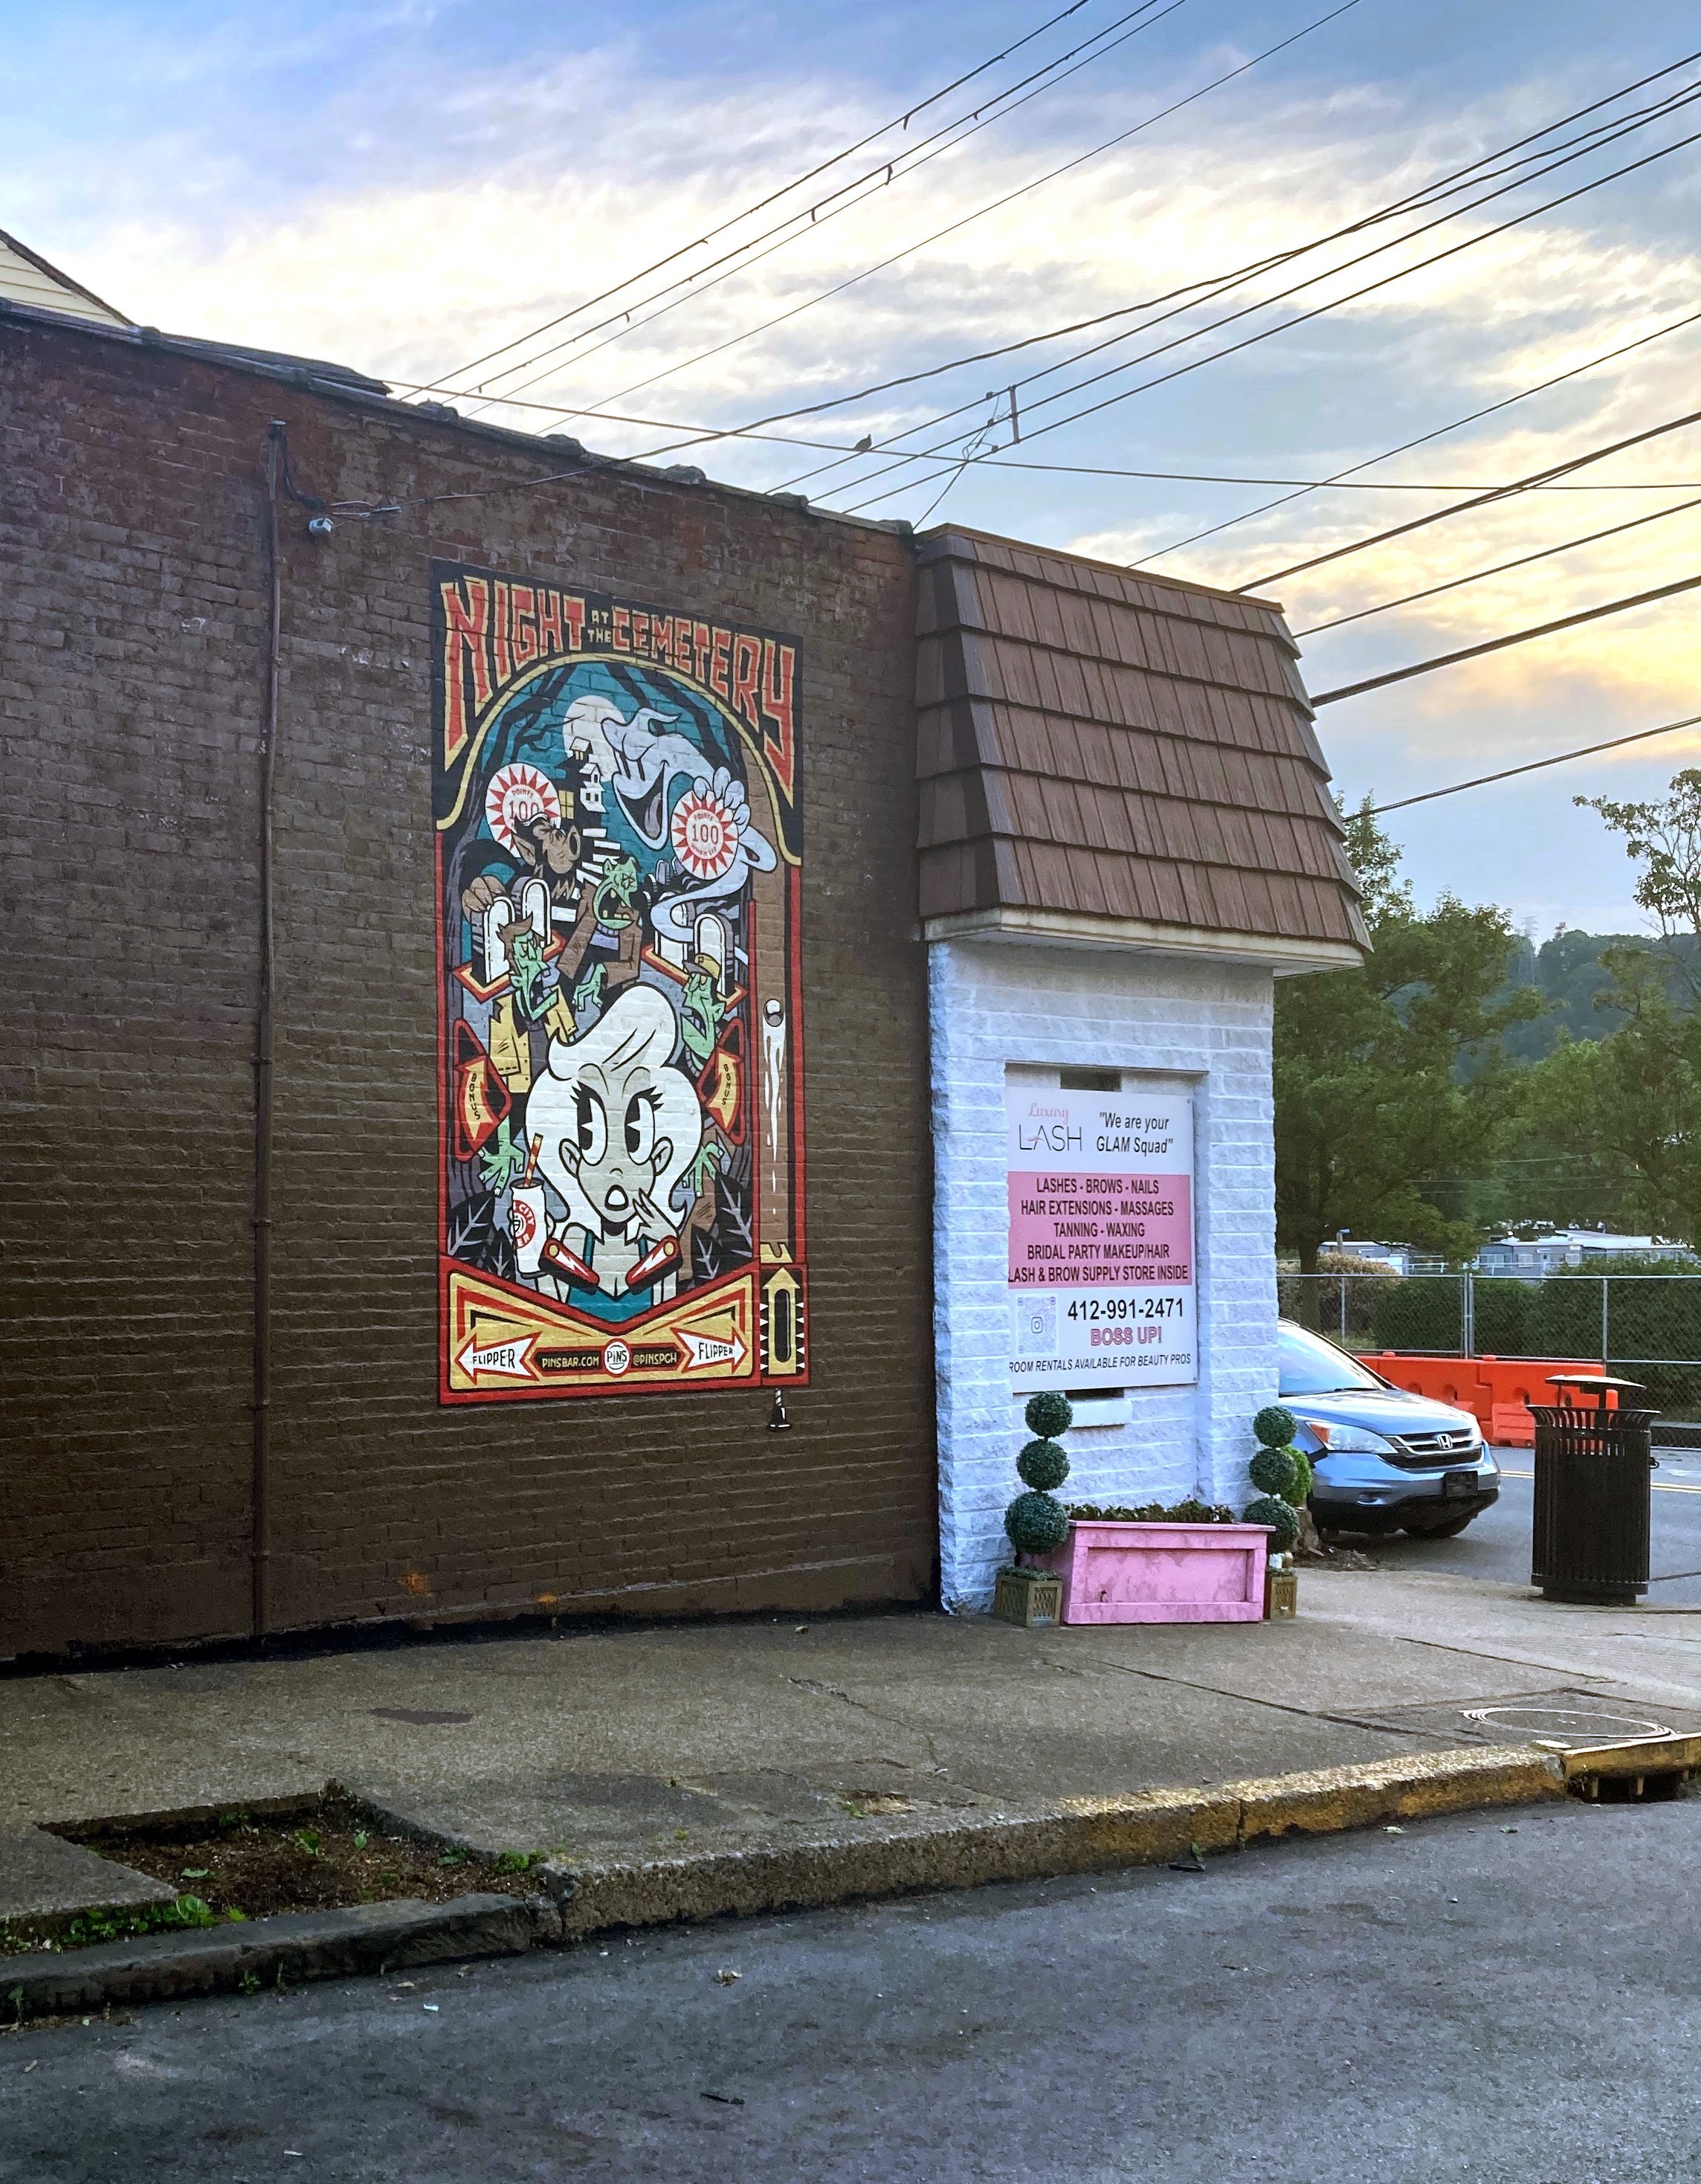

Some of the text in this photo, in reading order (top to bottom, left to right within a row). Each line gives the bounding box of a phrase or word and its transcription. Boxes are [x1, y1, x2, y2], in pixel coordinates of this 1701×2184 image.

[440, 576, 795, 809] NIGHT AT THE CEMETERY
[692, 822, 719, 845] 100
[721, 1063, 731, 1106] BONUS
[468, 1072, 481, 1121] BONUS
[1028, 1102, 1069, 1125] Luxury
[1100, 1112, 1169, 1134] "We are your
[1019, 1124, 1082, 1152] LASH
[1097, 1136, 1174, 1157] GLAM Squad"
[1036, 1177, 1077, 1194] LASHES
[1085, 1179, 1123, 1194] BROWS
[1131, 1179, 1159, 1195] NAILS
[518, 1203, 535, 1225] CITY
[1021, 1199, 1046, 1216] HAIR
[1049, 1200, 1112, 1216] EXTENSIONS
[1120, 1200, 1174, 1216] MASSAGES
[1053, 1222, 1098, 1237] TANNING
[1106, 1222, 1146, 1237] WAXING
[1027, 1244, 1066, 1260] BRIDAL
[1068, 1244, 1101, 1260] PARTY
[1038, 1266, 1045, 1282] &
[1048, 1266, 1080, 1282] BROW
[1082, 1266, 1121, 1281] SUPPLY
[1123, 1265, 1155, 1281] STORE
[1157, 1265, 1189, 1280] INSIDE
[1067, 1298, 1184, 1321] 412-991-2471
[1090, 1327, 1134, 1347] BOSS
[472, 1347, 515, 1369] FLIPPER
[633, 1351, 677, 1366] @PINSPGH
[699, 1341, 733, 1360] FLIPPER
[541, 1356, 600, 1368] PINSBAR.COM
[1009, 1353, 1192, 1373] ROOM RENTALS AVAILABLE FOR BEAUTY PROS
